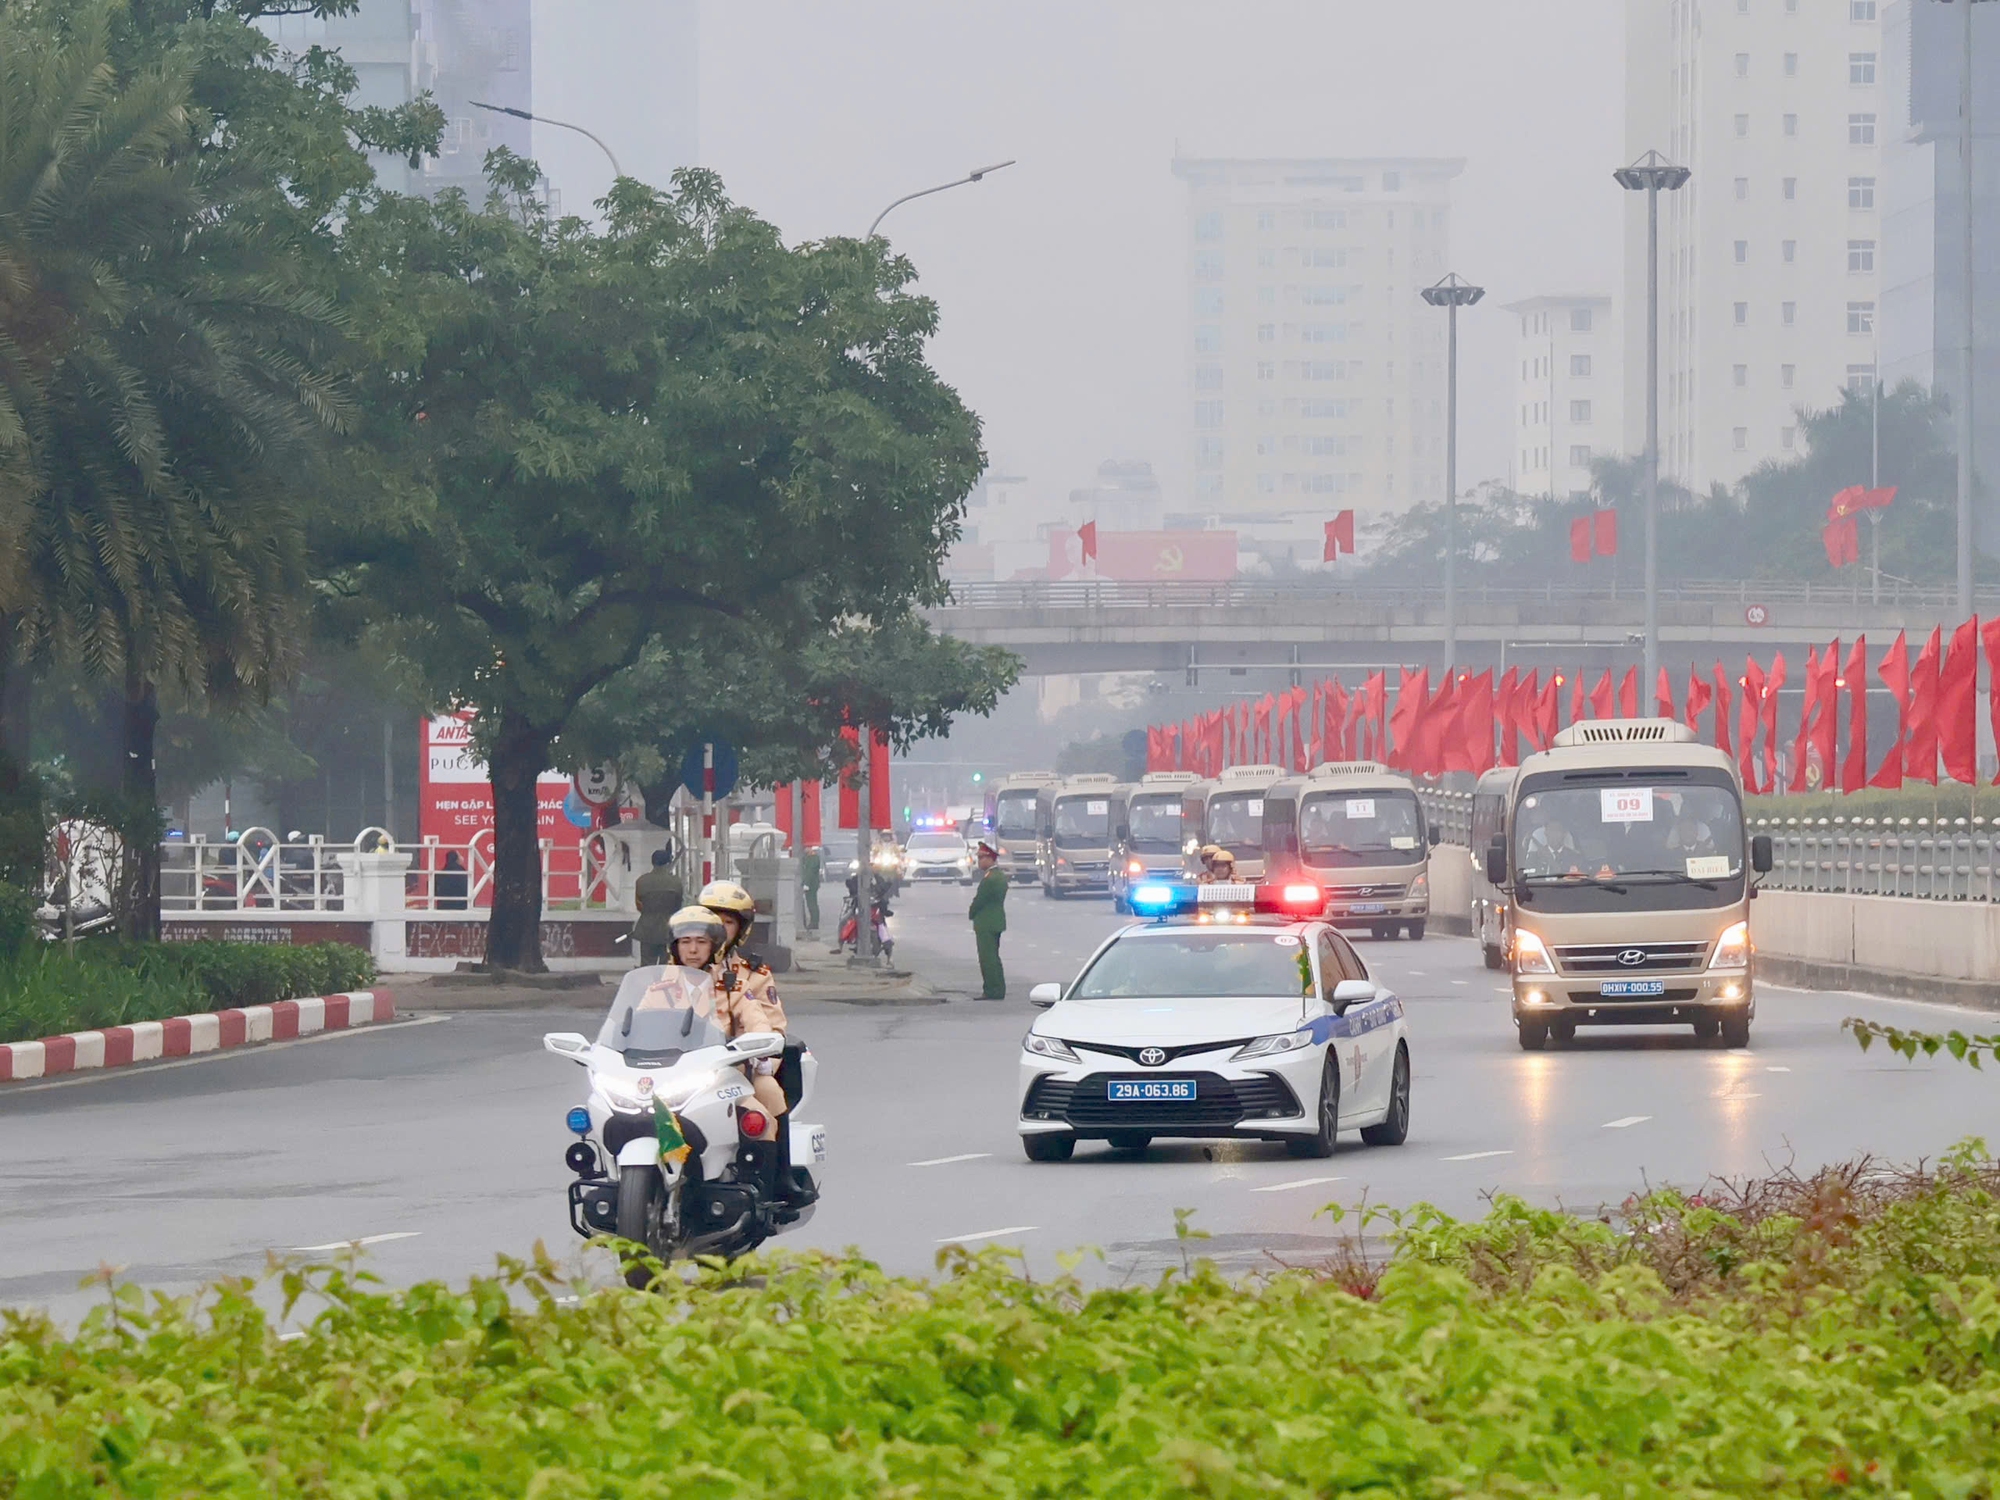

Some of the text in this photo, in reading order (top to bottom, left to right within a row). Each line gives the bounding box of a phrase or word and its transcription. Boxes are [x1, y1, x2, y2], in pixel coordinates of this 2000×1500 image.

[436, 800, 459, 811] HẸN
[461, 798, 484, 811] GẶP
[1616, 798, 1641, 811] 09
[455, 815, 478, 825] SEE
[717, 1086, 743, 1100] CSGT
[1116, 1084, 1189, 1097] 29A-063.86
